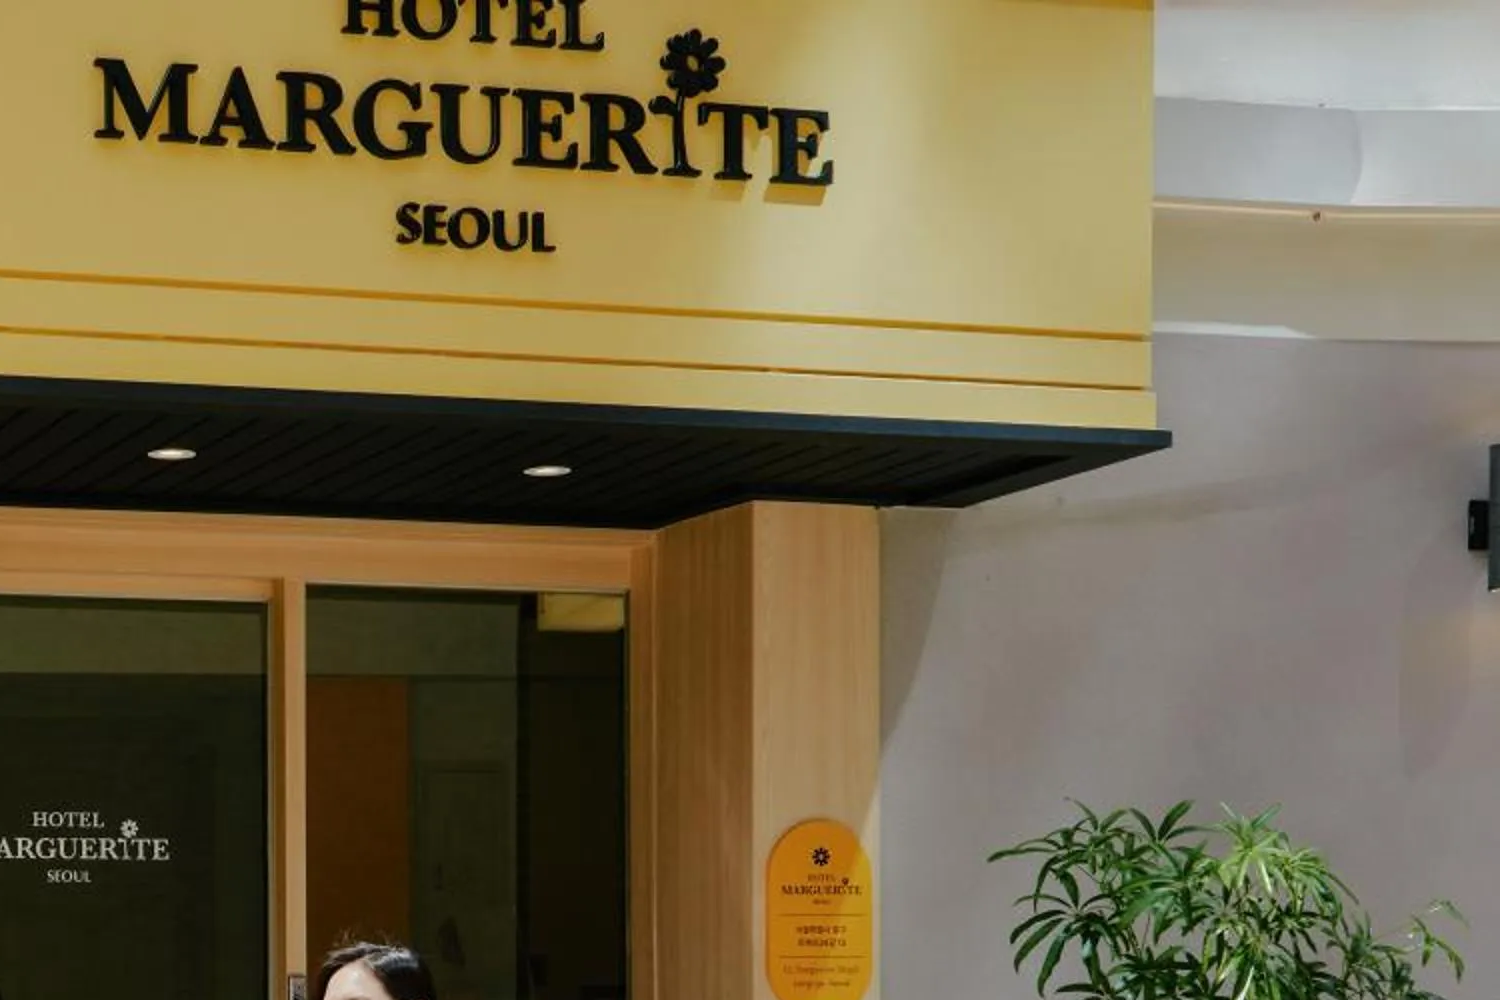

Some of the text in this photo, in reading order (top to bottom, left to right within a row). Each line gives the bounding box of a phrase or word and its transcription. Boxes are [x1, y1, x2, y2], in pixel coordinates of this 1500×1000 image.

[339, 0, 605, 51] HOTEL
[93, 28, 834, 187] MARGUERITE
[395, 202, 556, 254] SEOUL
[32, 811, 105, 828] HOTEL
[46, 869, 92, 883] SEOUL
